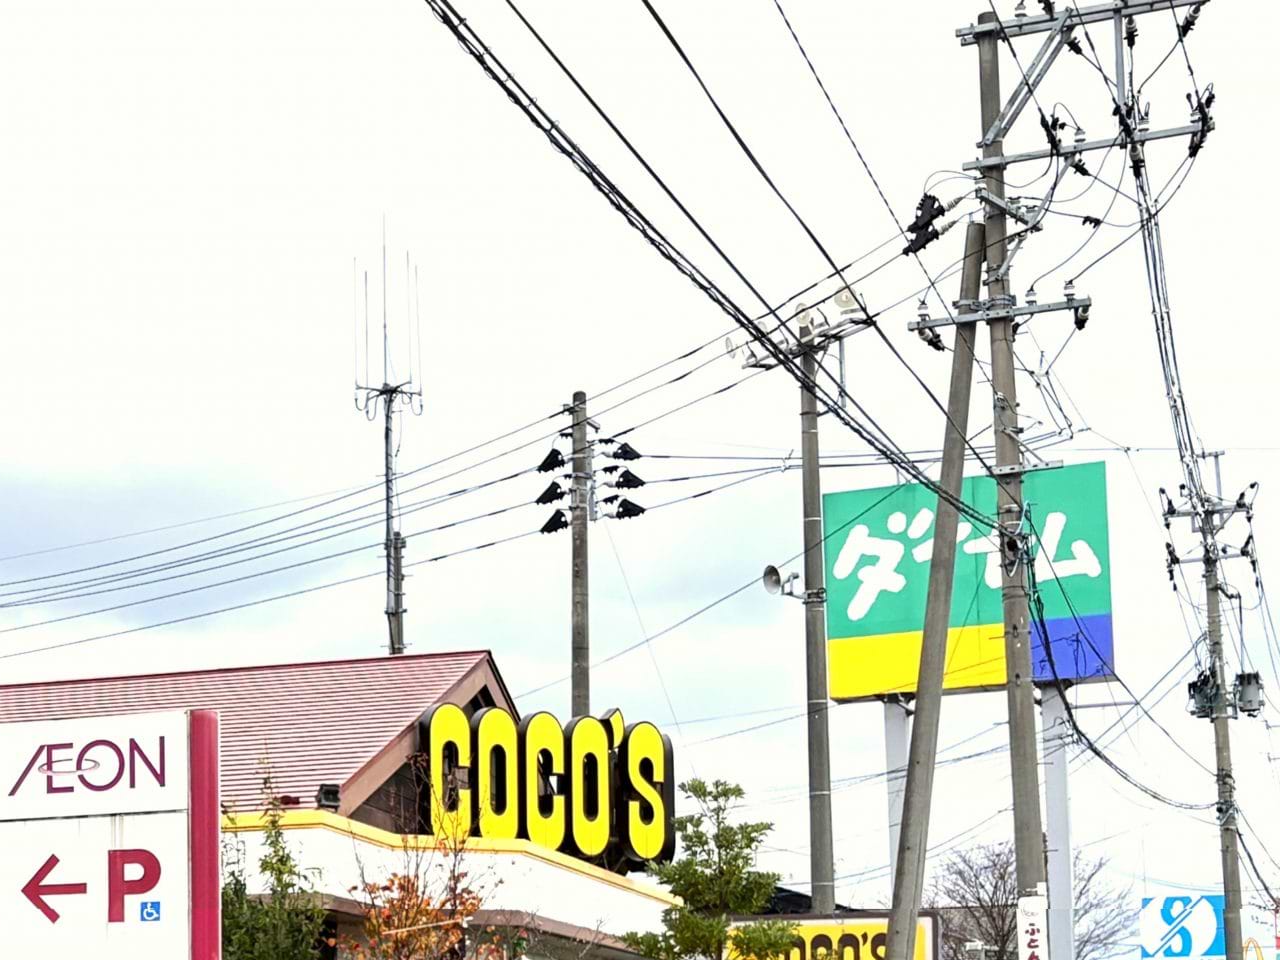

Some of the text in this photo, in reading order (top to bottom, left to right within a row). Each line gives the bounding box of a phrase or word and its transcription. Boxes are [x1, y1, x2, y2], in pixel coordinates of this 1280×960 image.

[832, 508, 1101, 621] ダム
[424, 702, 672, 861] COCO'S
[108, 849, 161, 923] P
